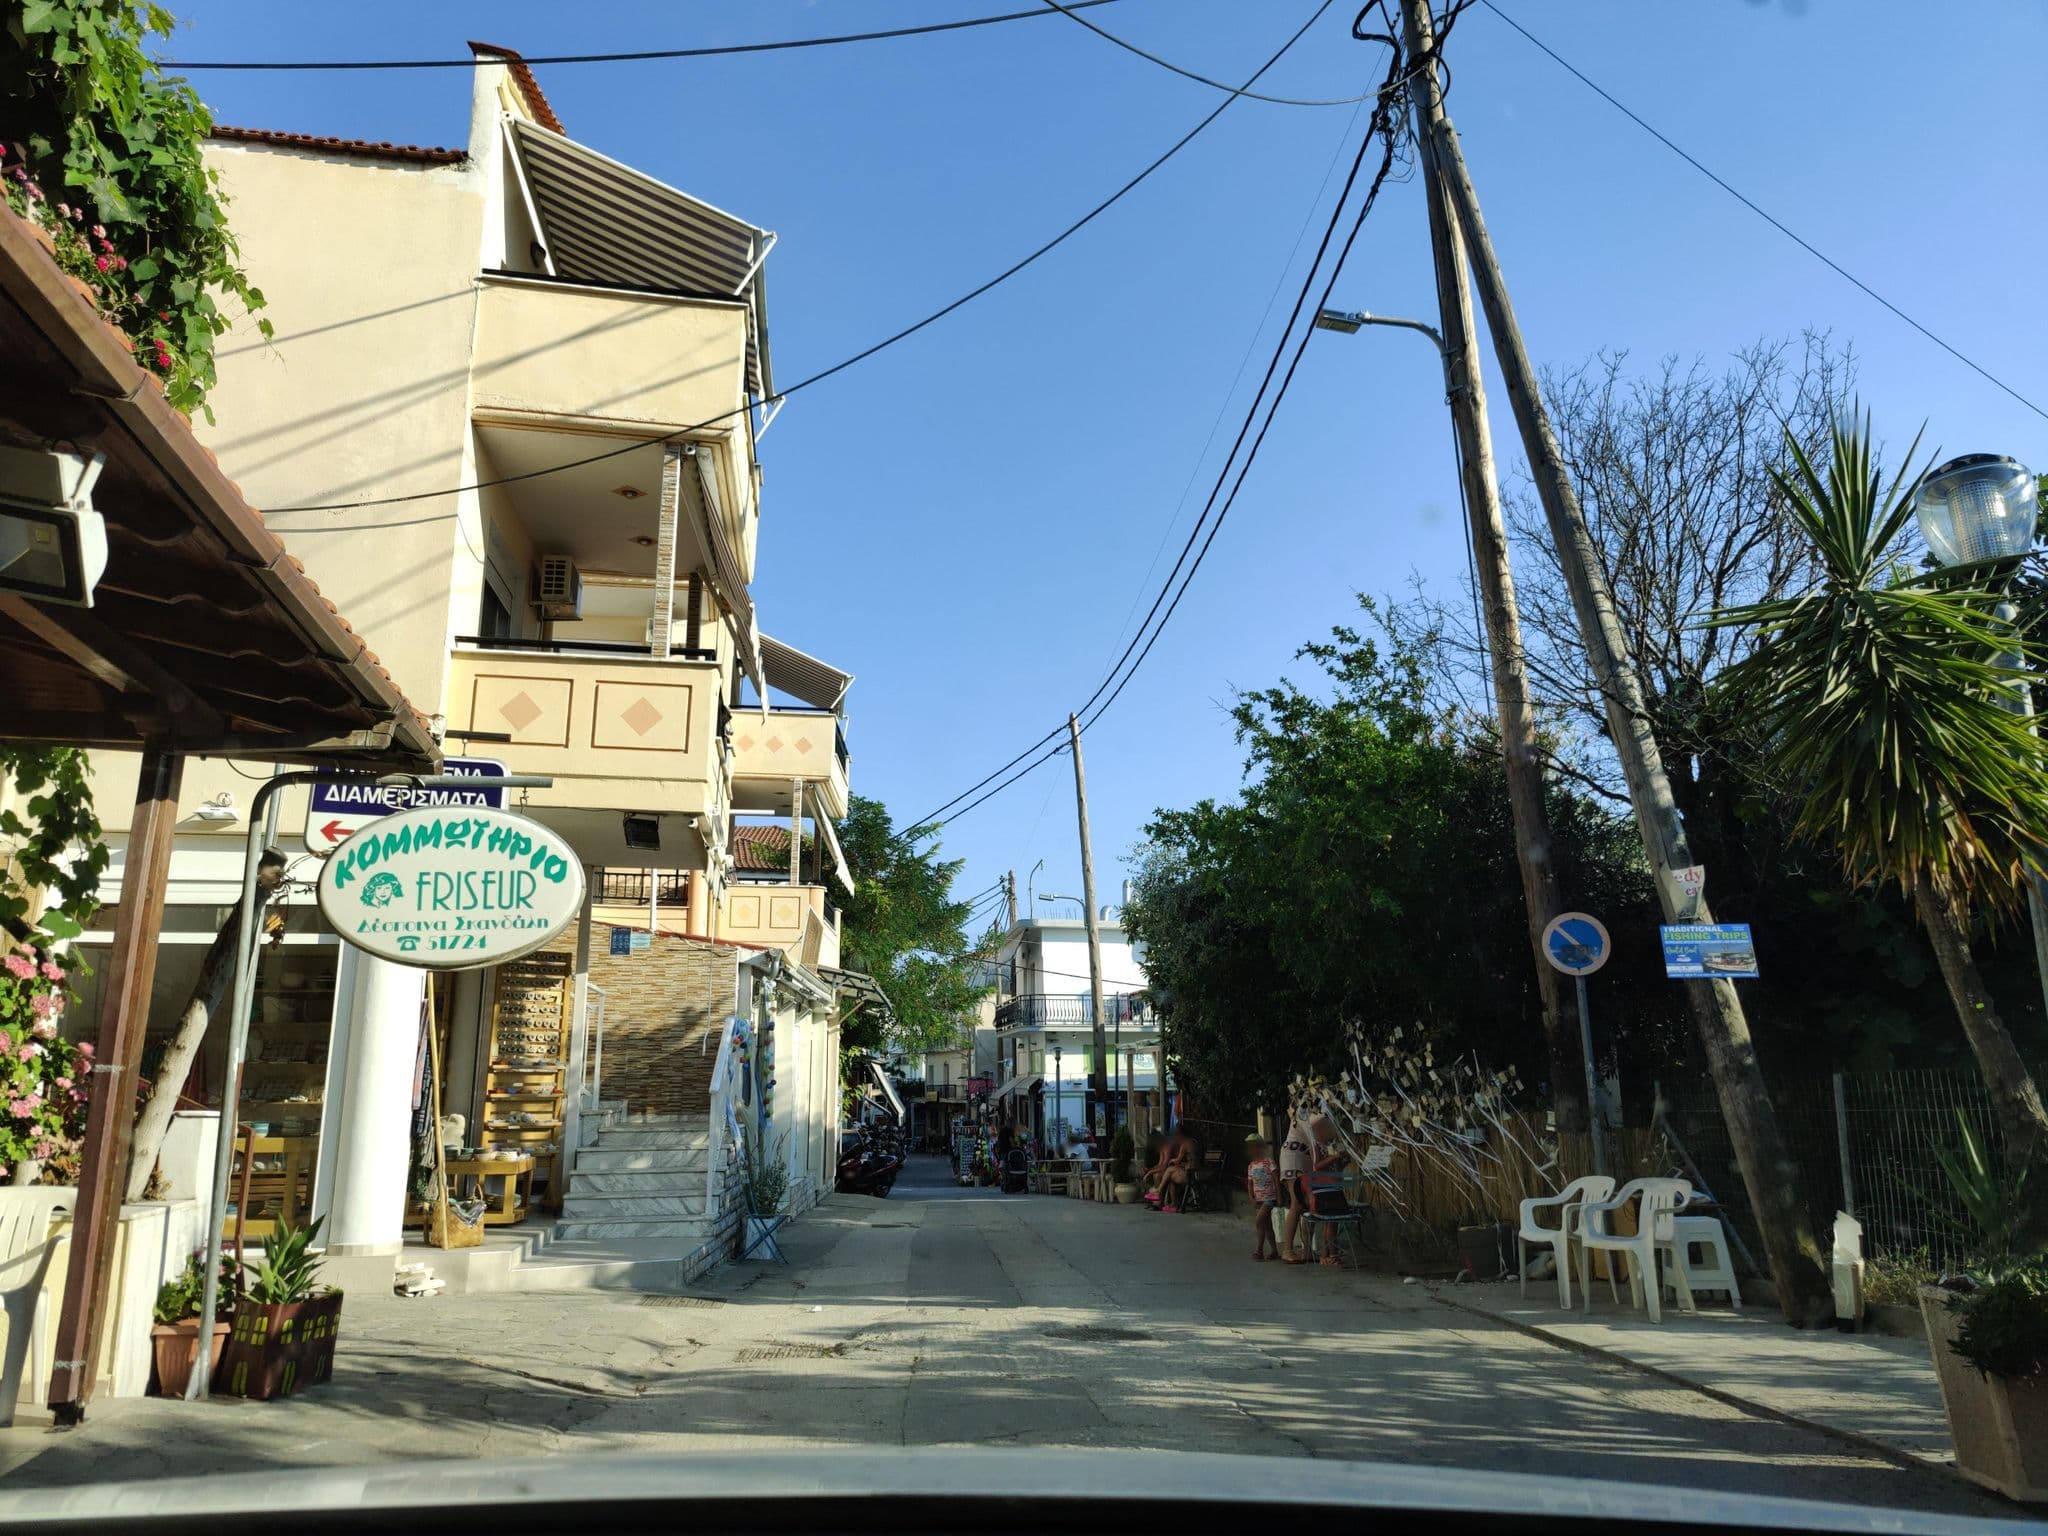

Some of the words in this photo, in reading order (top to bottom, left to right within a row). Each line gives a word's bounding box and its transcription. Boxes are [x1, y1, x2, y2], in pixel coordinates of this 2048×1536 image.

[324, 784, 488, 806] ΔΙΑΜΕΡΙΣΜΑΤΑ
[416, 870, 537, 911] FRISEUR
[357, 917, 447, 933] Δέσποινα
[455, 914, 549, 931] Σκανδάλη
[428, 935, 487, 950] 51724
[1664, 932, 1711, 940] FISHING
[1715, 931, 1749, 940] TRIPS
